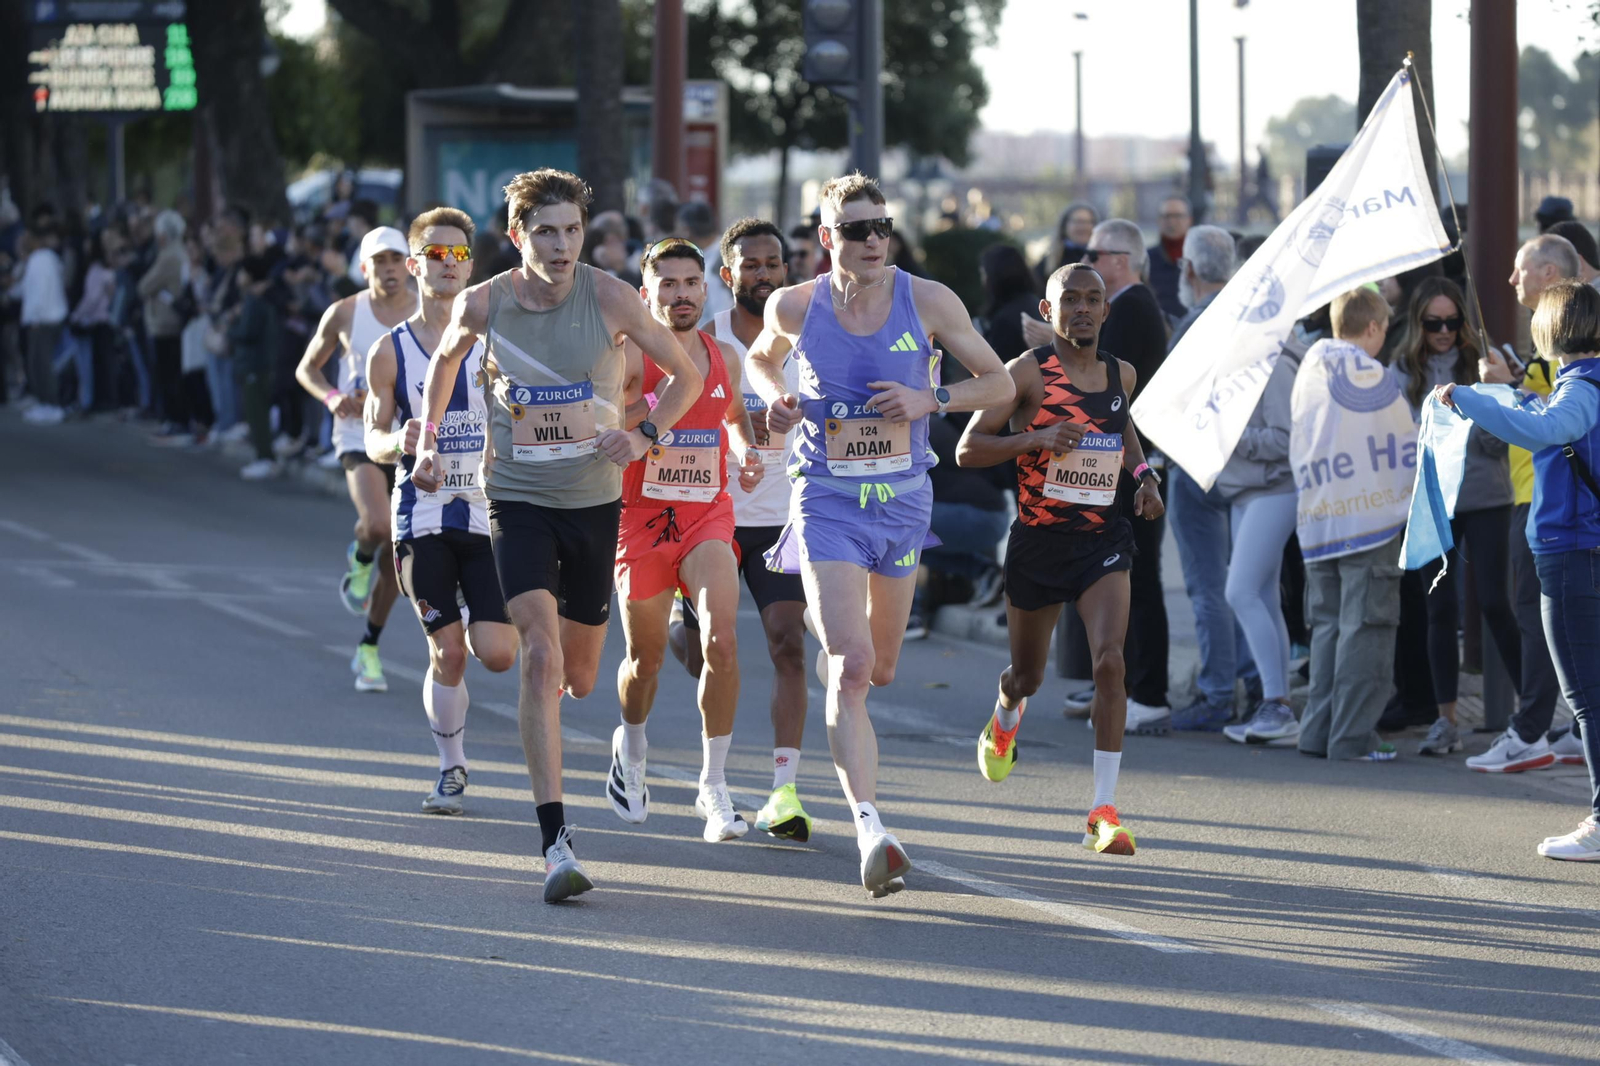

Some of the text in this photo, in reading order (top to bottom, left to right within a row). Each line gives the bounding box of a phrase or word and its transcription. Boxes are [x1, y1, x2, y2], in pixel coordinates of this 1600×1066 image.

[536, 388, 583, 401] ZURICH
[743, 398, 767, 408] ZURI
[853, 405, 880, 415] ZUR
[443, 410, 485, 424] UZKOA
[543, 412, 561, 422] 117
[438, 422, 482, 437] ROLAK
[534, 426, 574, 442] WILL
[859, 425, 878, 436] 124
[678, 434, 715, 444] ZURICH
[1081, 437, 1117, 448] ZURICH
[443, 440, 482, 451] ZURICH
[845, 440, 892, 457] ADAM
[451, 460, 460, 470] 31
[680, 454, 696, 465] 119
[1081, 457, 1098, 468] 102
[1298, 433, 1418, 491] ane Ha
[441, 473, 474, 487] RATIZ
[658, 467, 711, 484] MATIAS
[1055, 469, 1114, 488] MOOGAS
